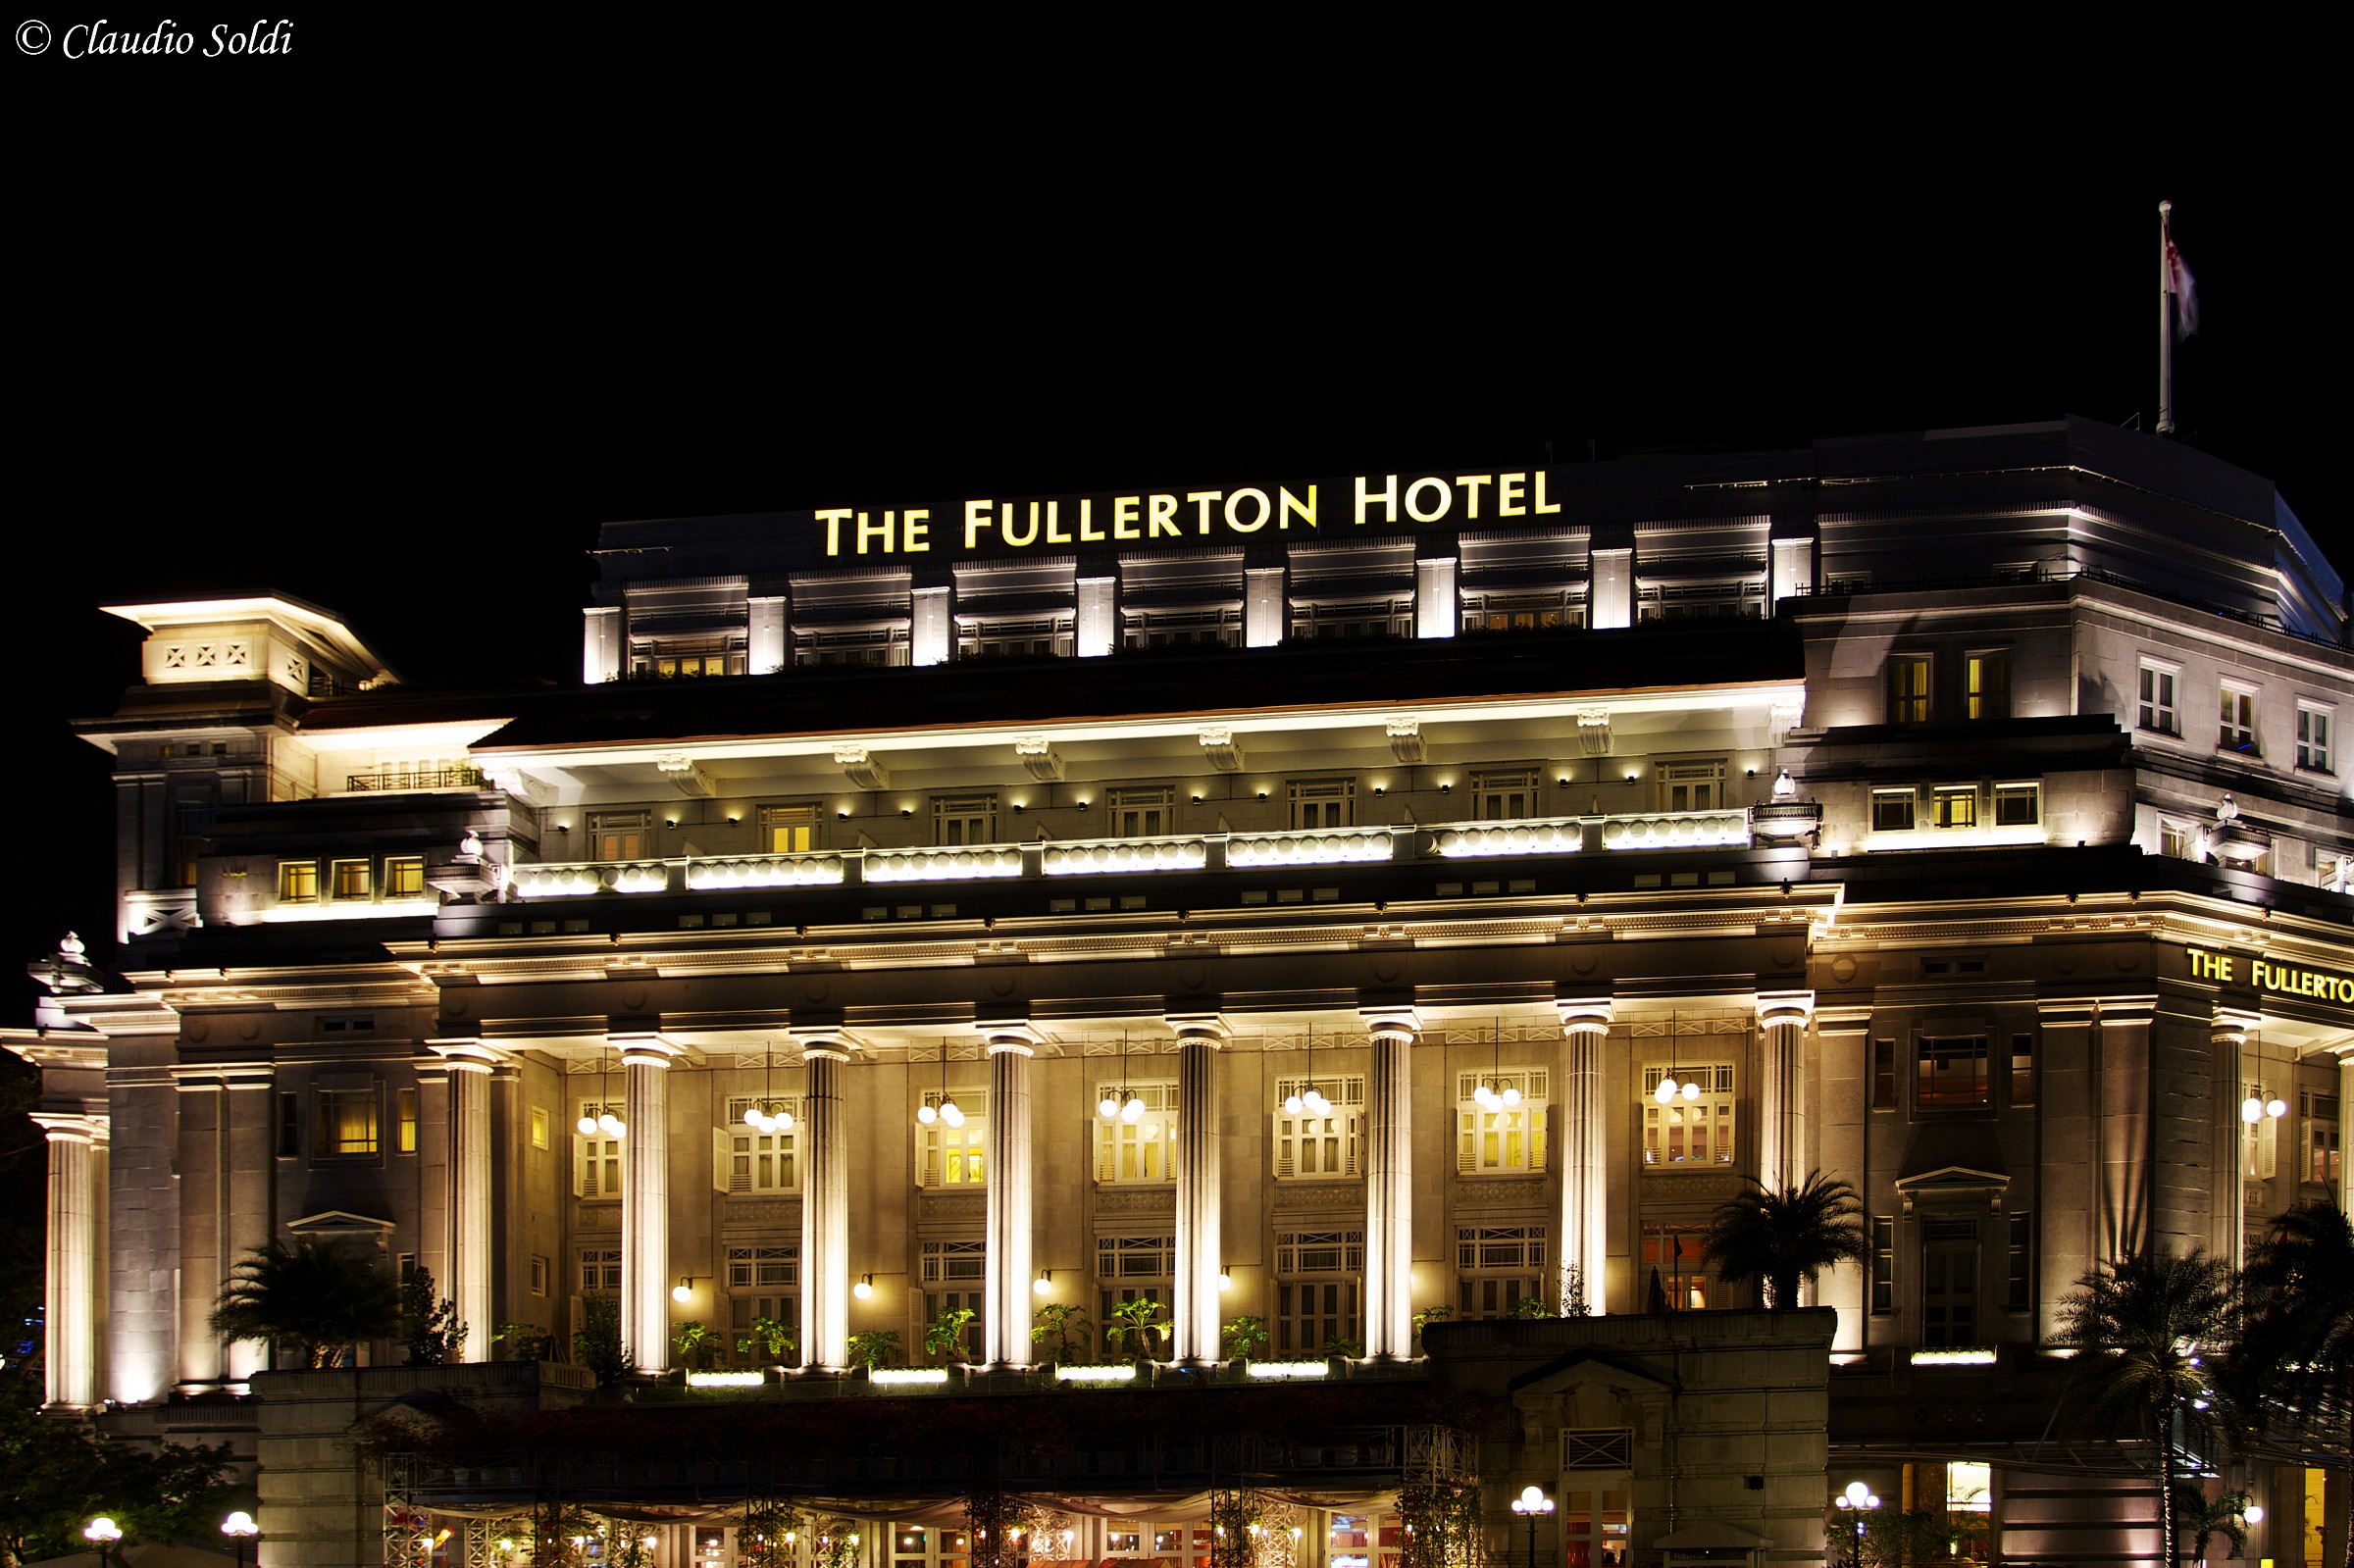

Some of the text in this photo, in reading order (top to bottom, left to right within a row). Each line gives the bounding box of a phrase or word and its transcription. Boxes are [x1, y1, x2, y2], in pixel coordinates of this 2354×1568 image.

[814, 471, 1561, 557] THE FULLERTON HOTEL
[2186, 947, 2233, 982] THE
